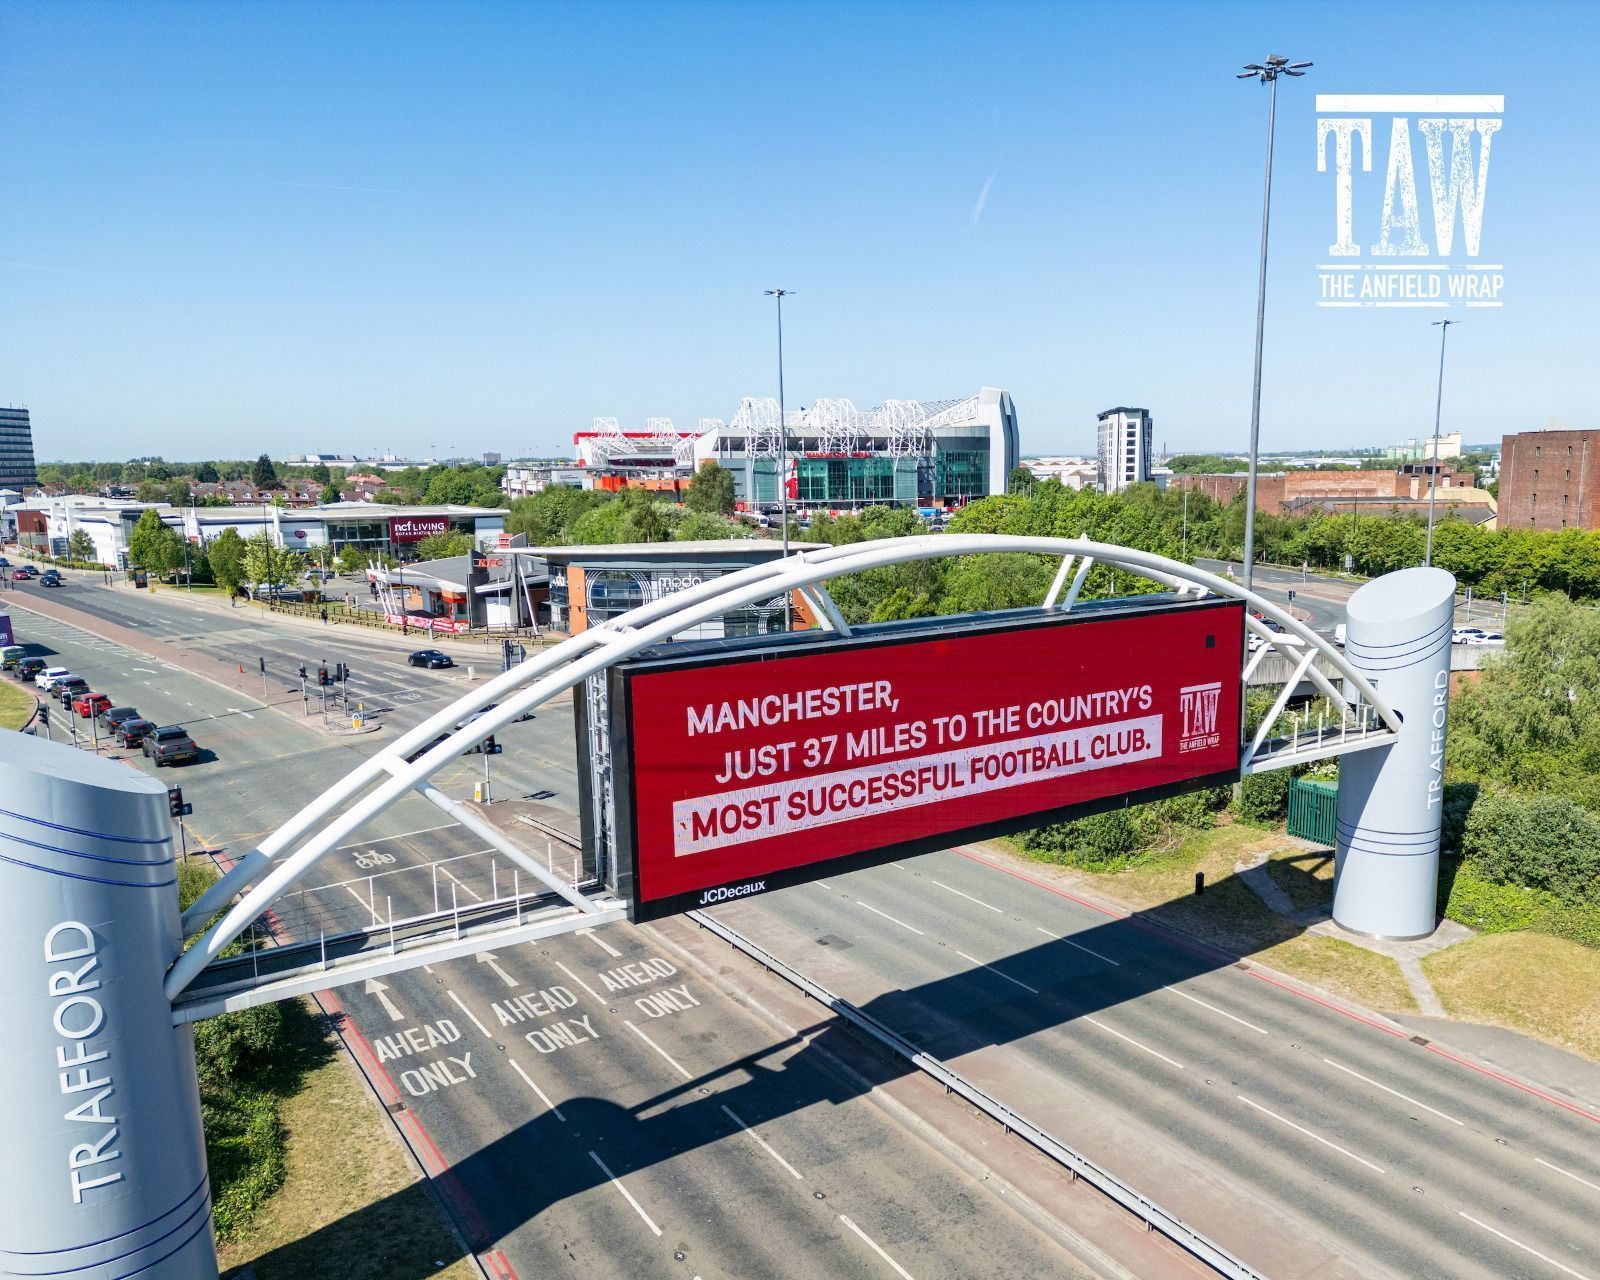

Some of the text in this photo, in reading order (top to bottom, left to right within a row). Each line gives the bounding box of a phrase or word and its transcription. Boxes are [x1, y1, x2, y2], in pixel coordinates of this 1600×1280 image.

[394, 521, 445, 532] ncf LIVING
[478, 558, 503, 567] KFC
[686, 680, 900, 737] MANCHESTER,
[1180, 688, 1222, 738] TAW
[715, 684, 1153, 784] JUST 37 MILES TO THE COUNTRY'S
[1180, 741, 1189, 751] THE
[1188, 738, 1207, 750] ANFIELD
[1427, 669, 1448, 810] TRAFFORD
[692, 728, 1152, 842] MOST SUCCESSFUL FOOTBALL CLUB.
[699, 880, 766, 904] JCDecaux
[598, 957, 679, 993] AHEAD
[491, 985, 578, 1028] AHEAD
[634, 984, 701, 1019] ONLY
[373, 1019, 462, 1064] AHEAD
[525, 1014, 600, 1054] ONLY
[44, 920, 122, 1204] TRAFFORD
[400, 1052, 477, 1097] ONLY
